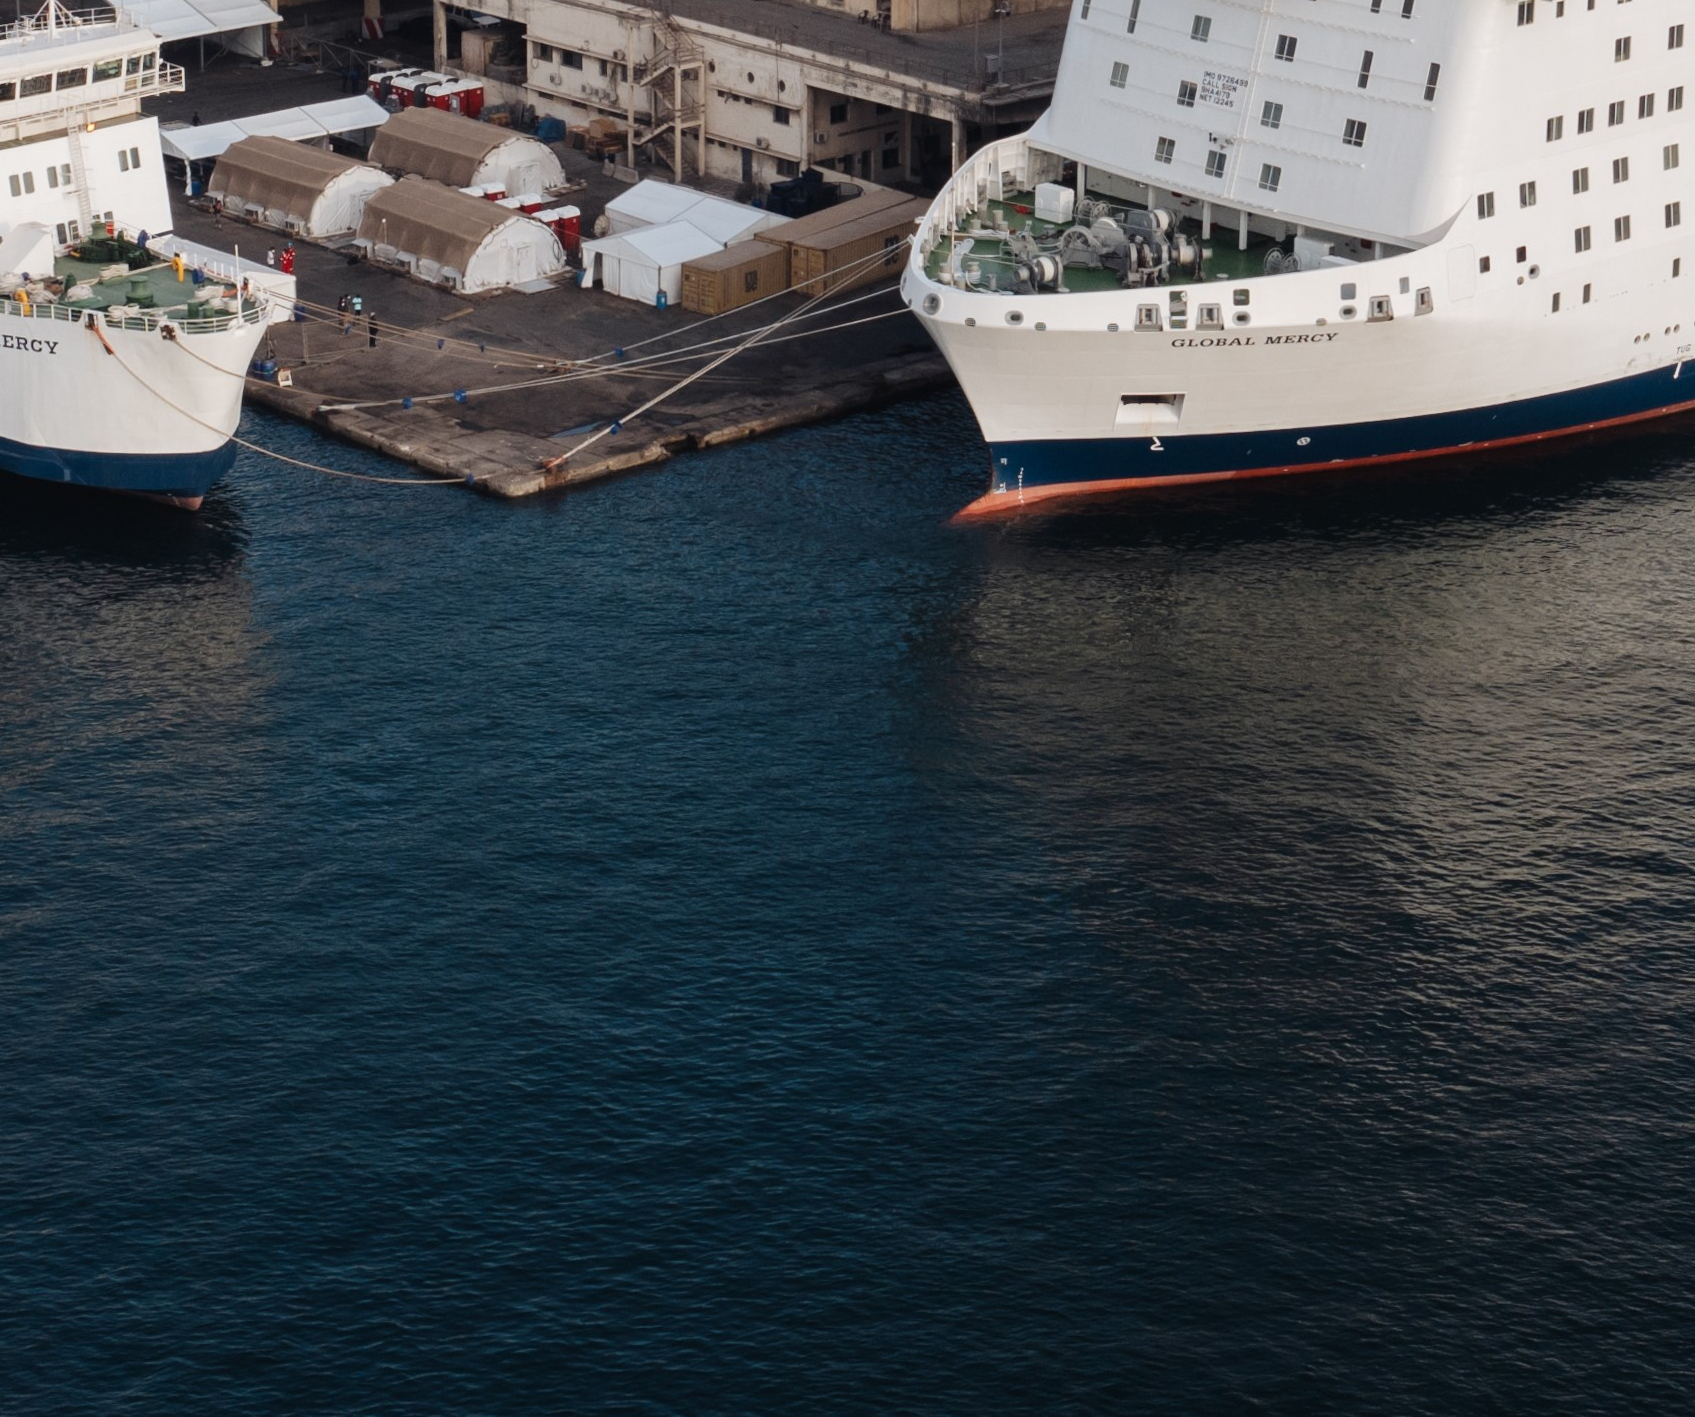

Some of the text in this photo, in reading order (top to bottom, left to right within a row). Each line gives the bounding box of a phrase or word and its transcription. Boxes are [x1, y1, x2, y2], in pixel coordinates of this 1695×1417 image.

[1203, 71, 1216, 80] IMO
[1202, 78, 1238, 93] CALL SIGN
[1199, 93, 1234, 108] NET 12245
[1170, 332, 1340, 348] GLOBAL MERCY
[1676, 343, 1692, 355] TUG
